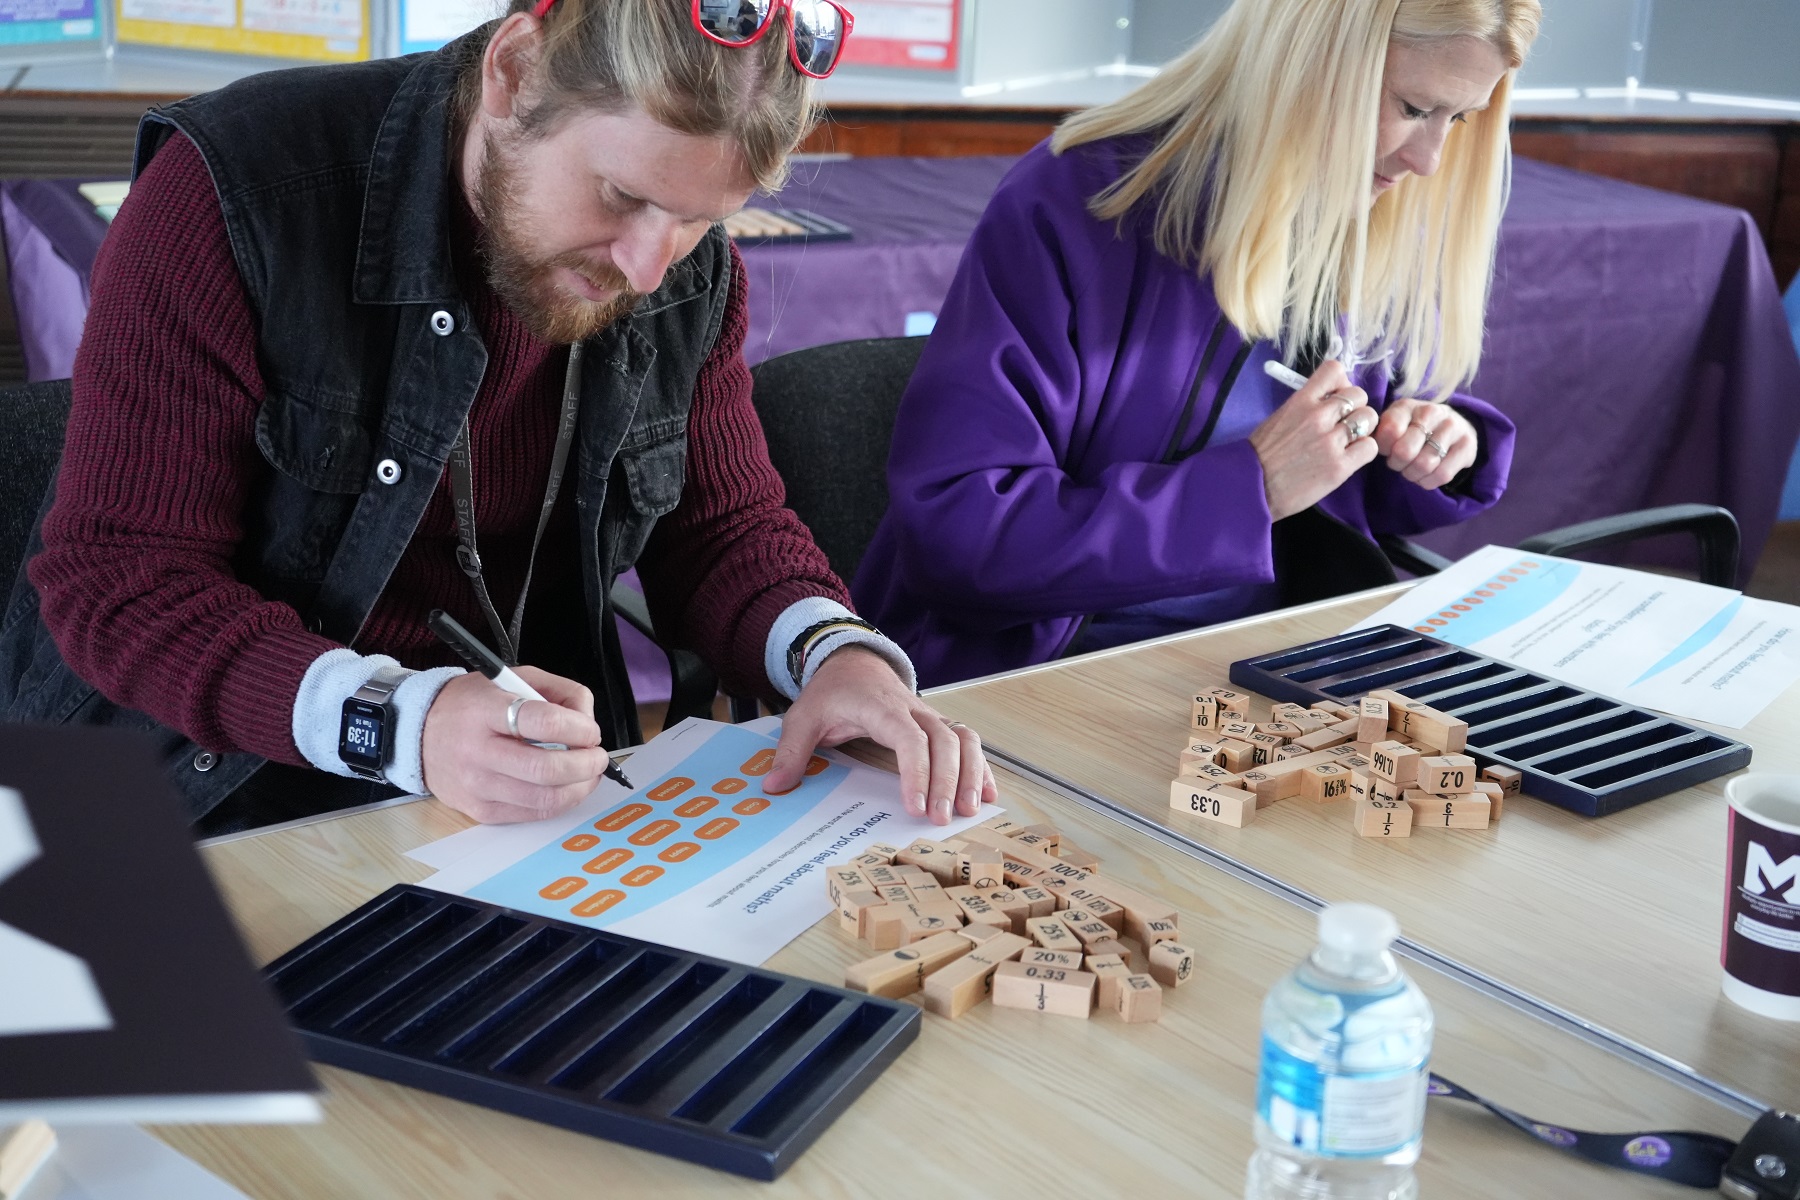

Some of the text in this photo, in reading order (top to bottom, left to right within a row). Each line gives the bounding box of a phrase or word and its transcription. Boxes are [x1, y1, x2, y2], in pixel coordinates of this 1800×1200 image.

[563, 392, 578, 440] STAFF
[457, 498, 471, 546] STAFF
[347, 726, 376, 748] 11:39
[1200, 764, 1227, 776] 25%
[1374, 752, 1394, 775] 0.166
[1440, 771, 1464, 788] 0.2
[657, 781, 685, 798] Confused
[850, 801, 864, 810] Pick
[1191, 794, 1220, 816] 0.33
[828, 815, 842, 825] word
[817, 824, 830, 832] that
[804, 833, 818, 841] best
[743, 811, 891, 913] How do you feel about maths?
[857, 854, 878, 864] 0.1
[744, 874, 758, 882] feel
[838, 871, 863, 886] 25%
[1050, 863, 1090, 881] 100%
[1071, 890, 1094, 900] 0.1
[1148, 922, 1173, 931] 10%
[1033, 951, 1069, 964] 20%
[1026, 967, 1066, 981] 0.33
